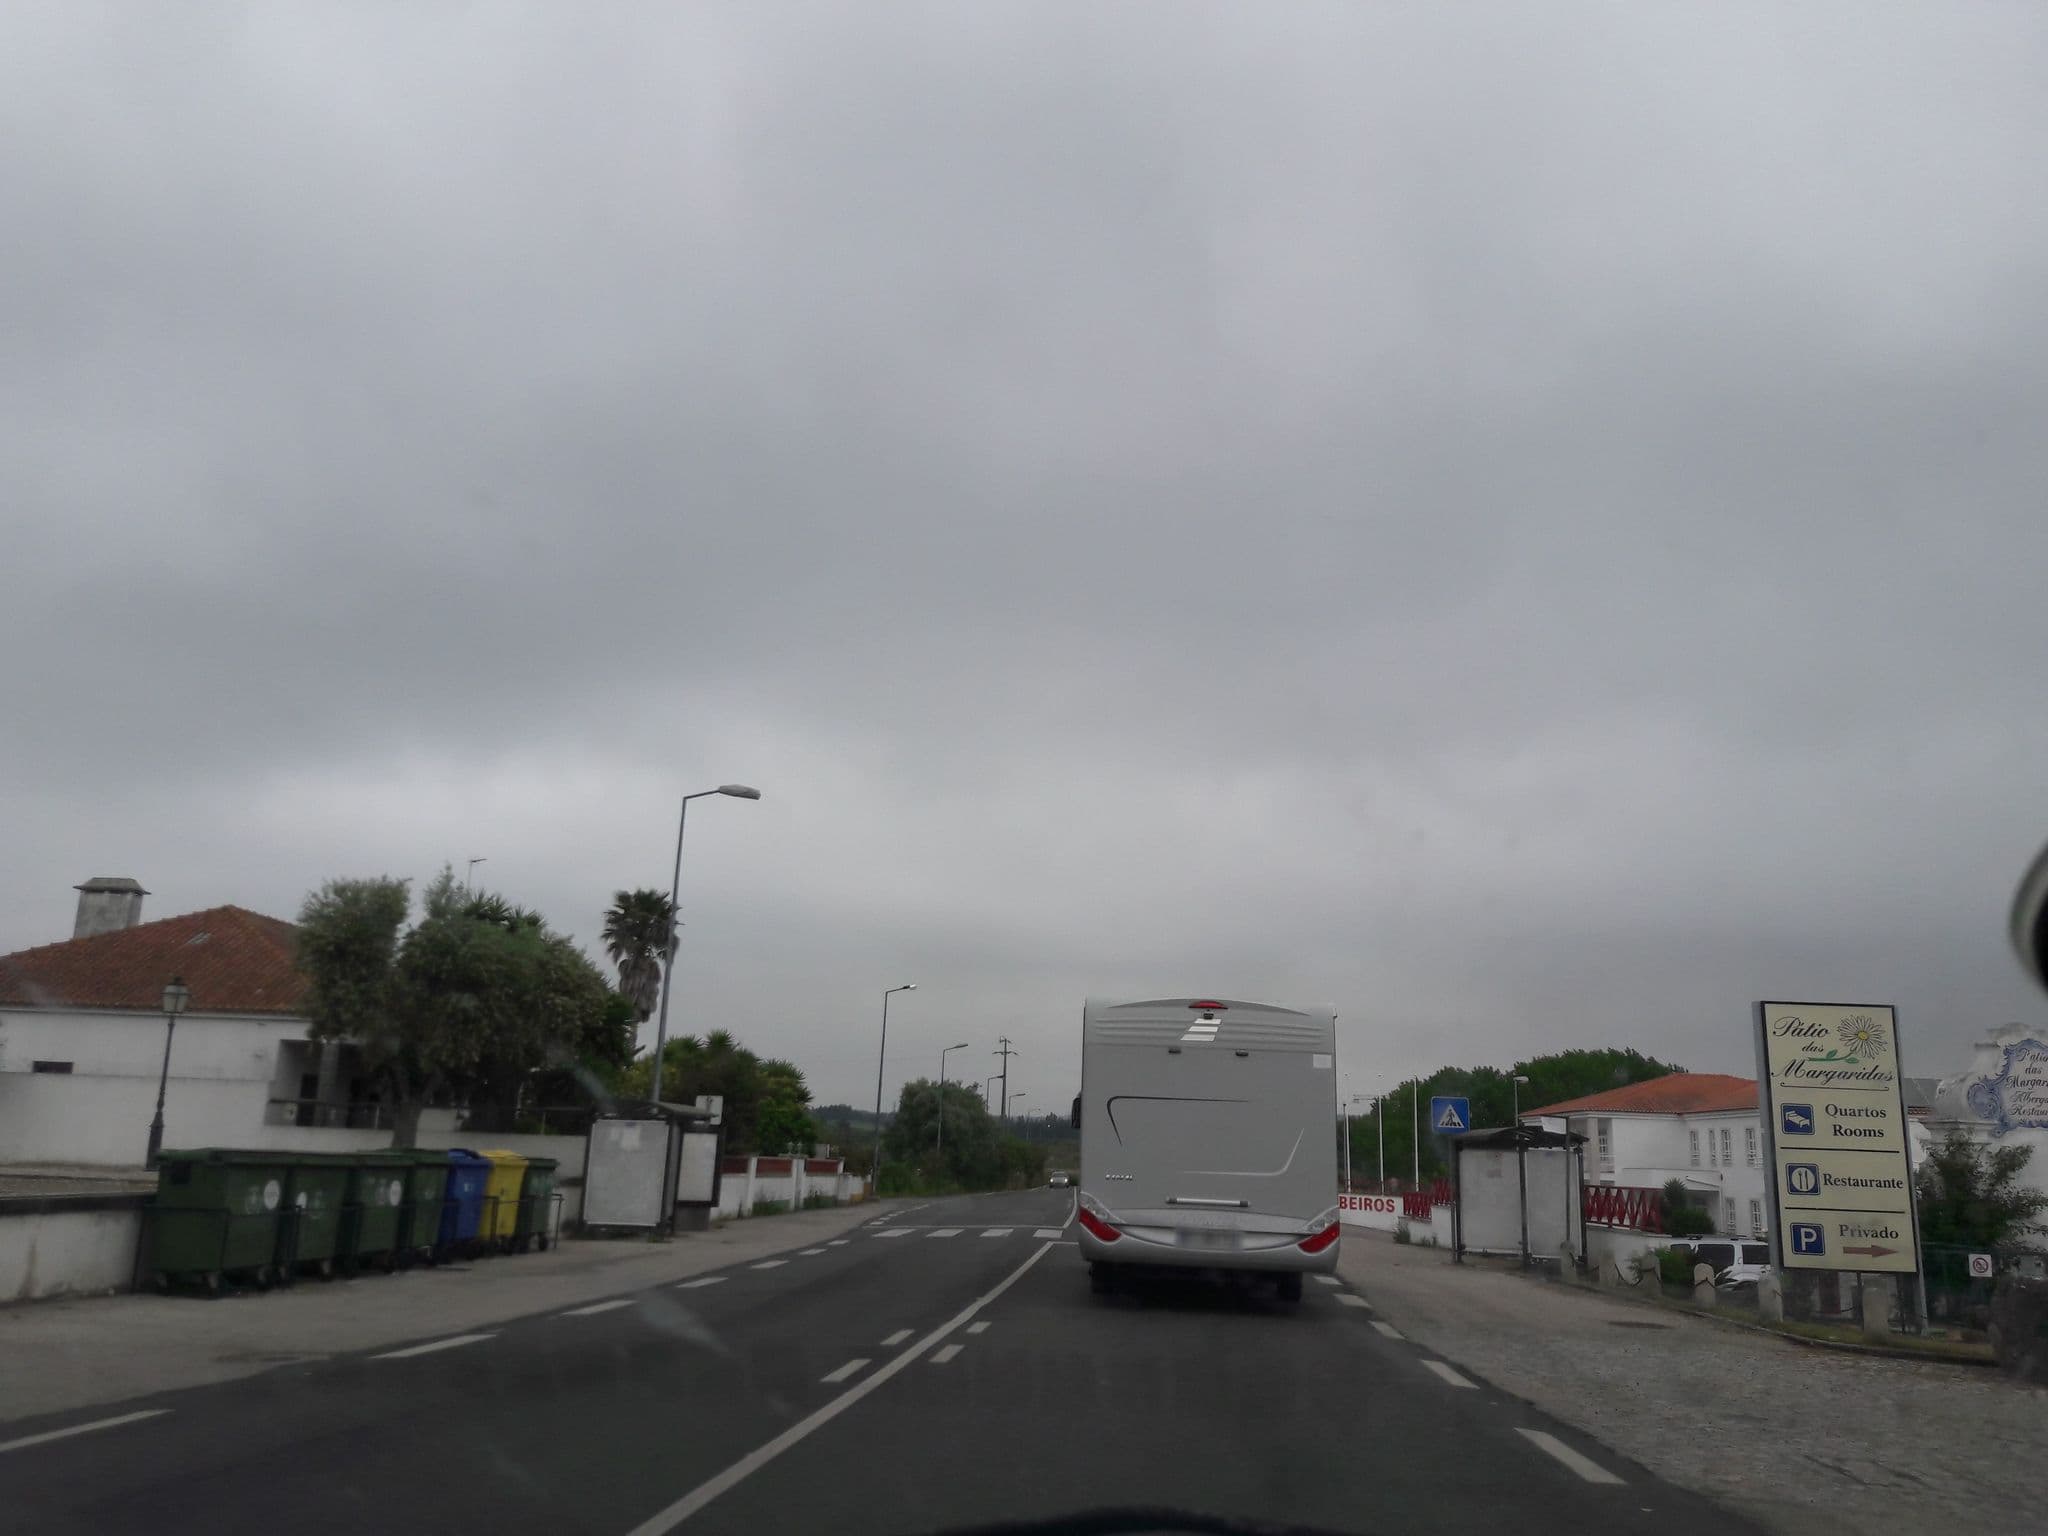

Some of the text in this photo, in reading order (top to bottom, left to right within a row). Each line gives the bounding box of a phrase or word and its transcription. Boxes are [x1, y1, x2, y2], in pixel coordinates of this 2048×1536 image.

[1773, 1016, 1829, 1038] Pátio
[1801, 1041, 1824, 1053] das
[1771, 1059, 1895, 1086] Margaridas
[1825, 1103, 1887, 1119] Quartos
[1832, 1124, 1885, 1138] Rooms
[1822, 1173, 1904, 1189] Restaurante
[1339, 1196, 1395, 1213] BEIROS
[1800, 1227, 1817, 1251] P
[1838, 1224, 1899, 1239] Privado
